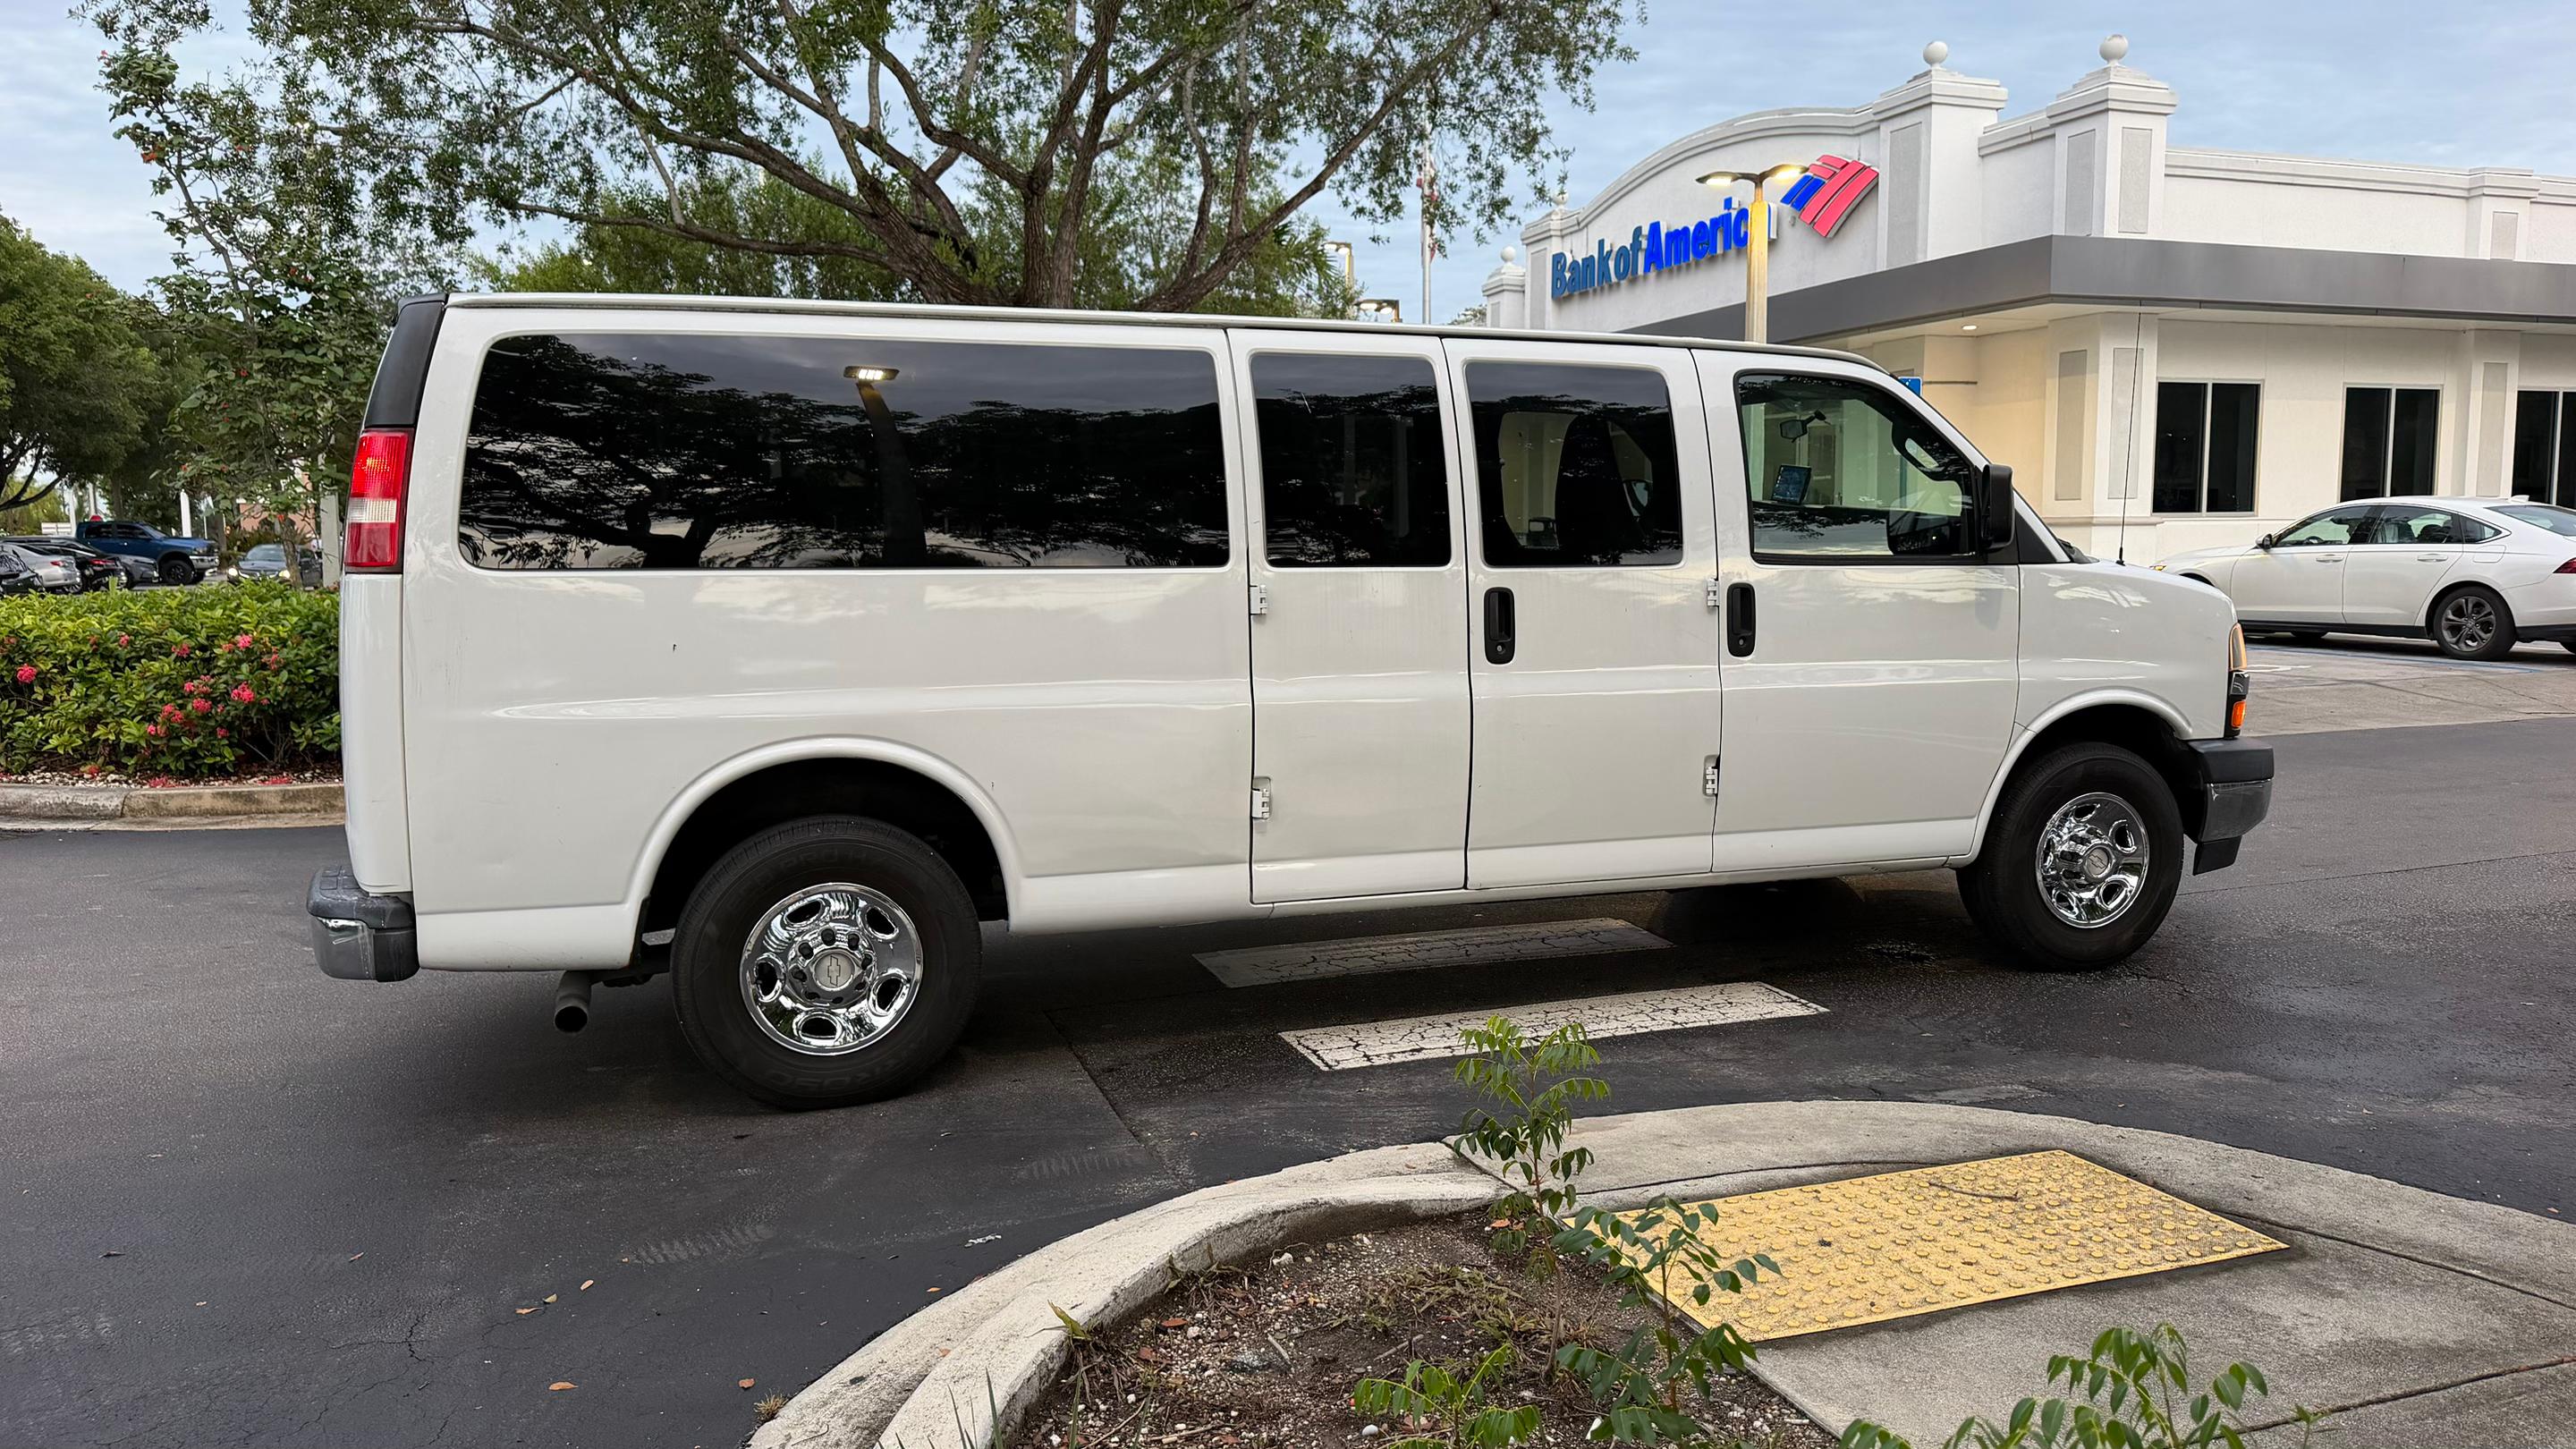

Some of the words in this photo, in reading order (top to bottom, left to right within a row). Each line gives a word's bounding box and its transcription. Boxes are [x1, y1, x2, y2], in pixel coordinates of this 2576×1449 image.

[1552, 238, 1614, 301] Bank
[1614, 225, 1642, 281] of
[1643, 196, 1773, 273] Americ
